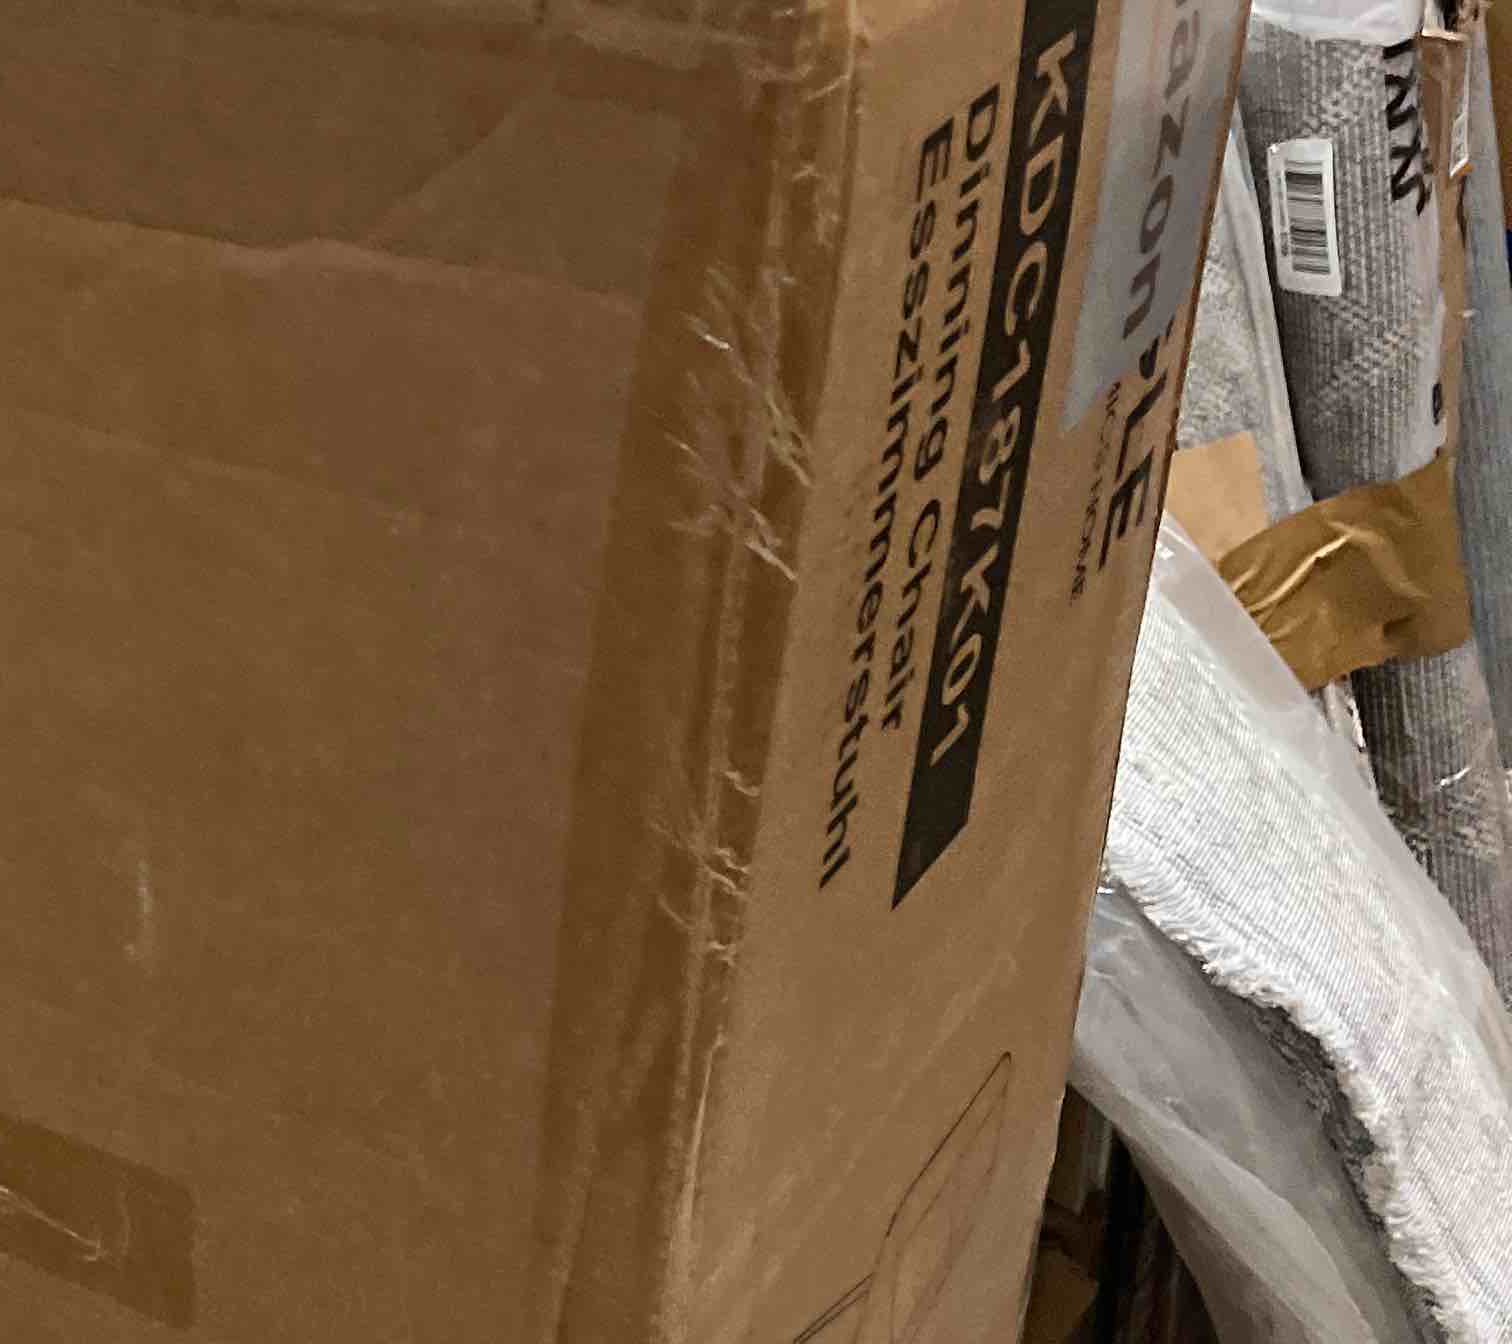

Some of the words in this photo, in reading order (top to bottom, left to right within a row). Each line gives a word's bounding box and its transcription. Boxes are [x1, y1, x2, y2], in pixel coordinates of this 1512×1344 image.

[818, 116, 955, 889] Esszimmerstuhl
[913, 82, 1001, 480] Dinning
[930, 26, 1078, 767] KDC187K01
[880, 499, 942, 731] Chair
